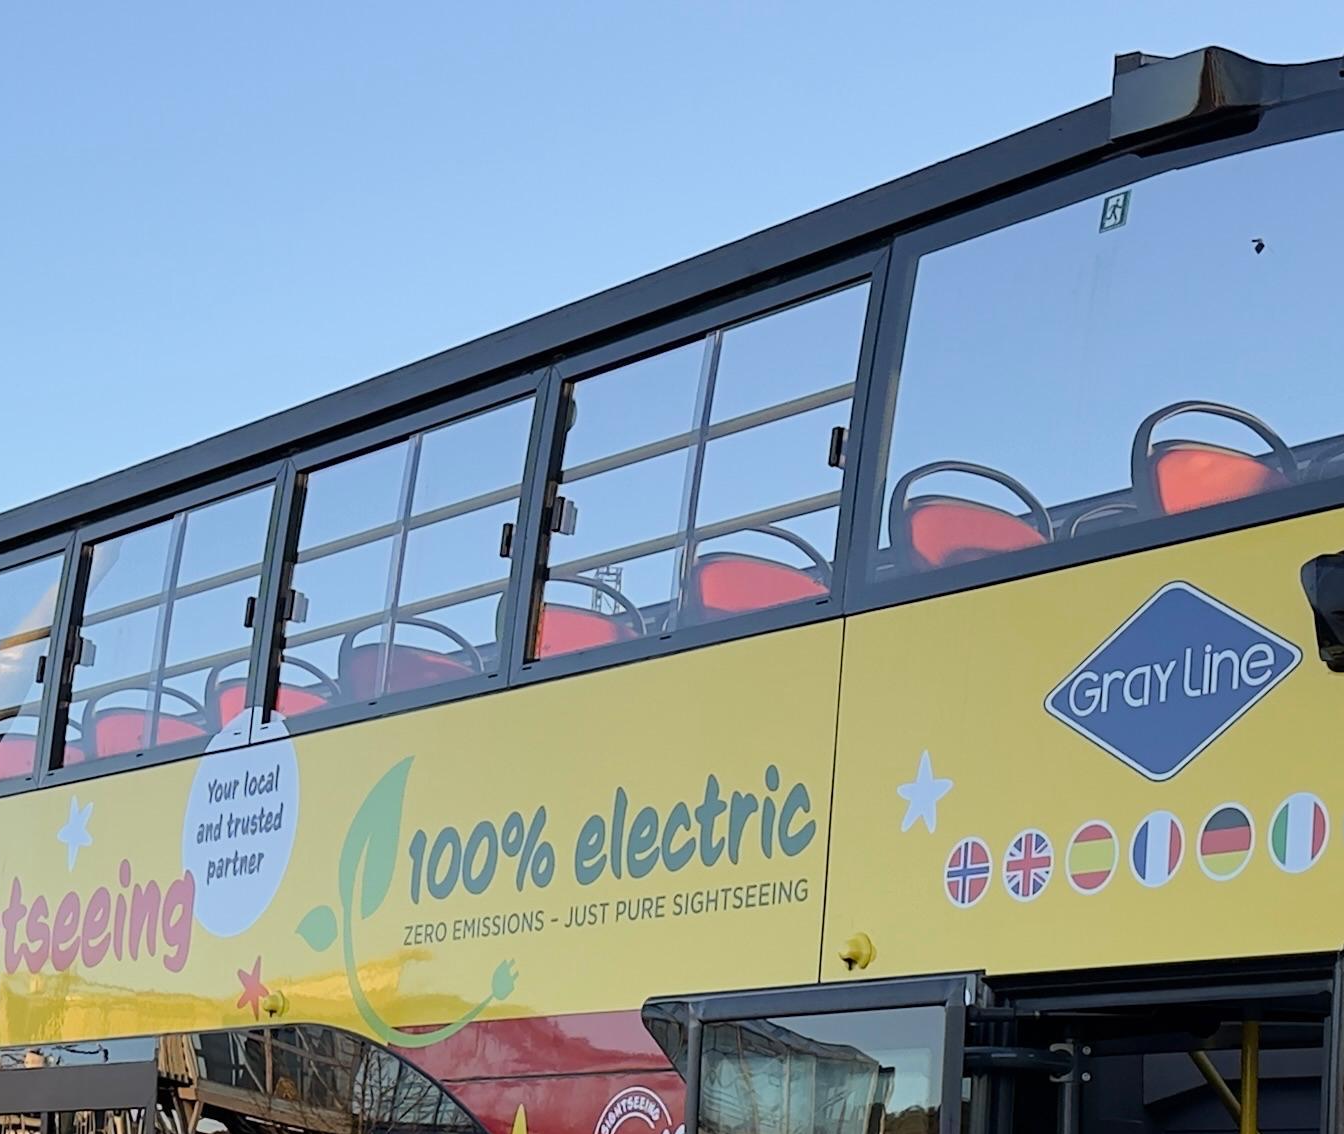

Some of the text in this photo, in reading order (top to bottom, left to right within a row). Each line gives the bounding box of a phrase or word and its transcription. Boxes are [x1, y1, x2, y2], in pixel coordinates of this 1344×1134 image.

[207, 764, 280, 803] Your local
[196, 802, 284, 845] and trusted
[409, 764, 817, 905] 100% electric
[207, 849, 265, 884] partner
[403, 922, 447, 947] ZERO
[452, 909, 545, 941] EMISSIONS
[564, 902, 610, 929] JUST
[615, 895, 666, 923] PURE
[672, 878, 809, 917] SIGHTSEEING
